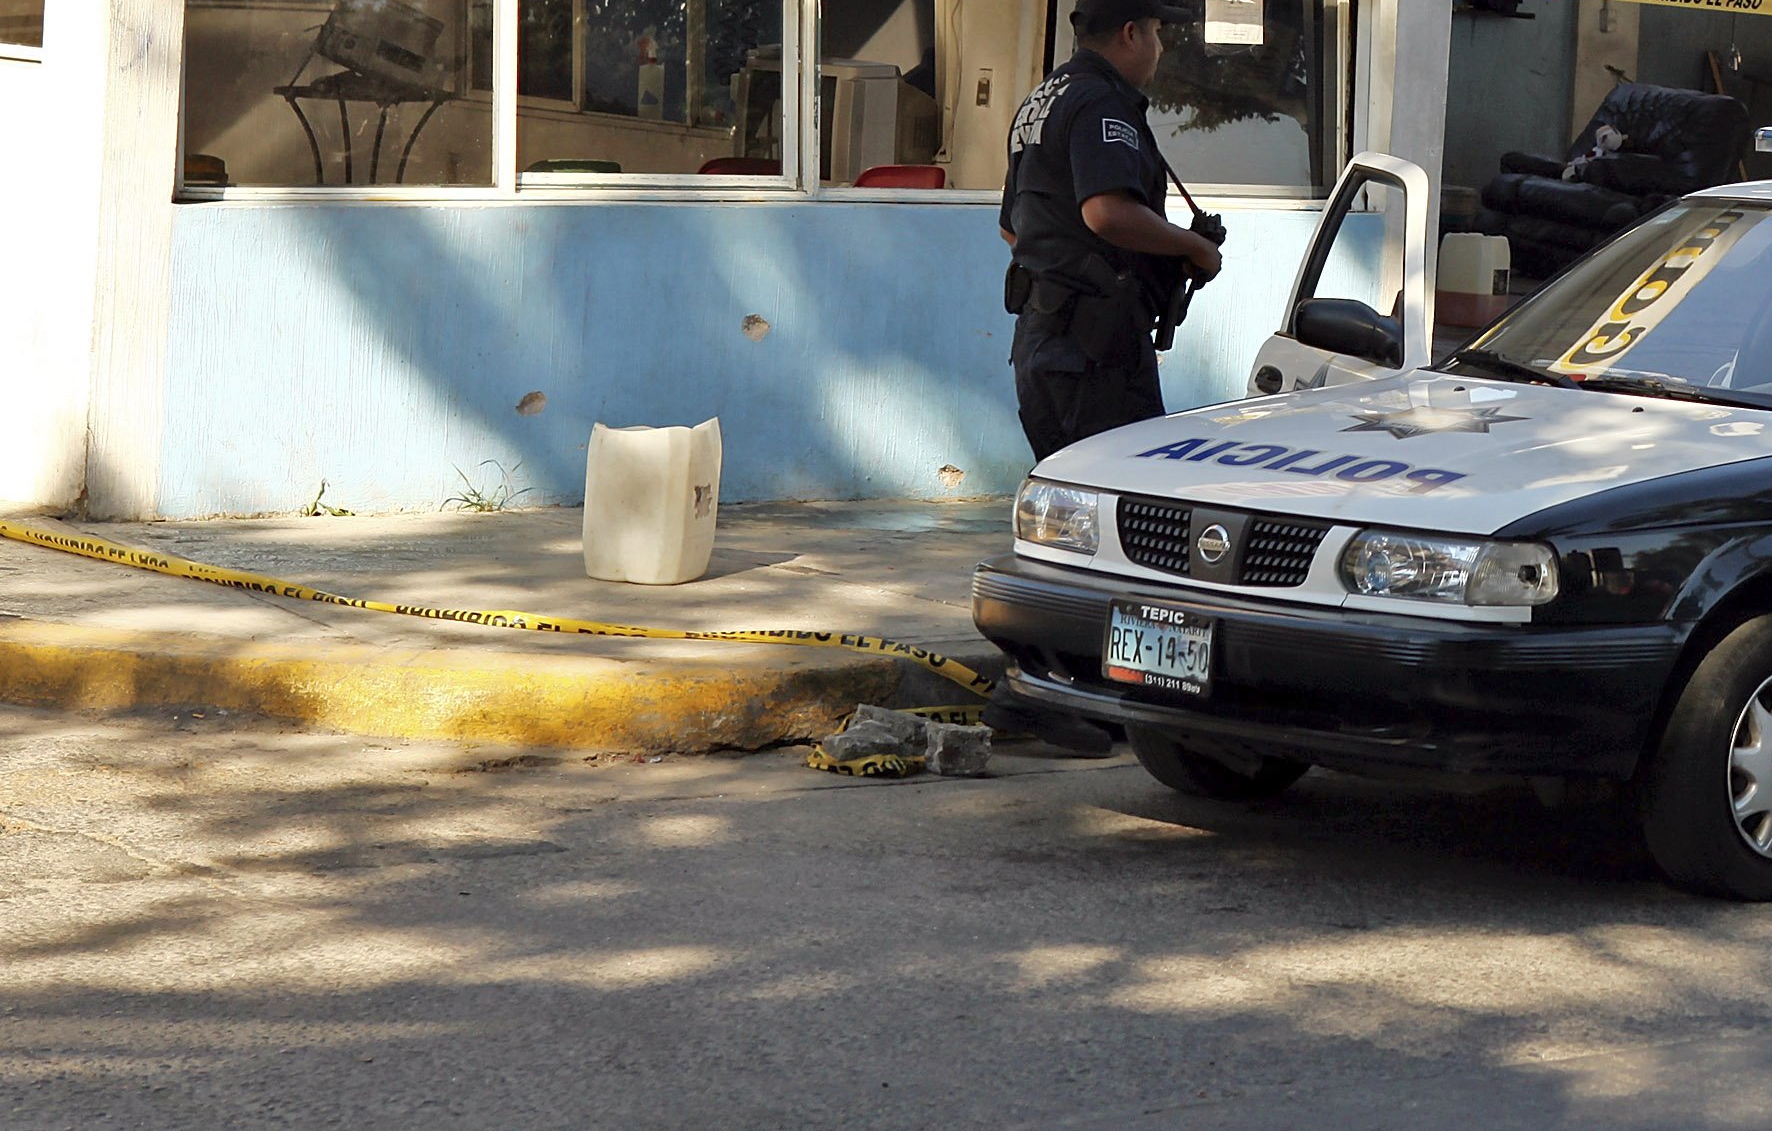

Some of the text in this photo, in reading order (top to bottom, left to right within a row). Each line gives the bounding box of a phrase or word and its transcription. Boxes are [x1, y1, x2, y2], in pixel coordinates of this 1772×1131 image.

[1141, 605, 1185, 624] TEPIC
[1110, 626, 1209, 673] REX-14-50
[1145, 673, 1164, 687] (311)
[1166, 678, 1180, 689] 211
